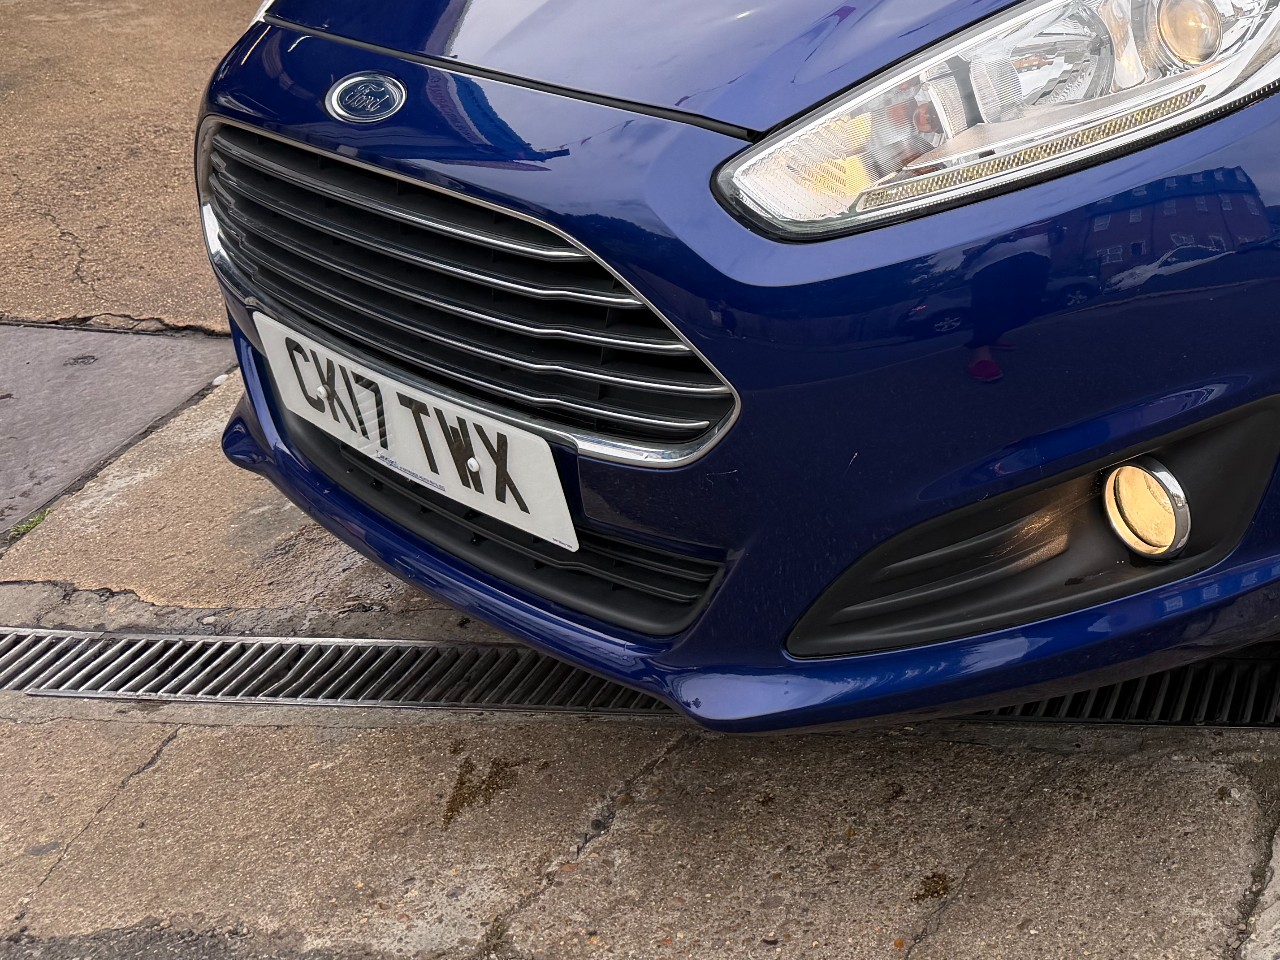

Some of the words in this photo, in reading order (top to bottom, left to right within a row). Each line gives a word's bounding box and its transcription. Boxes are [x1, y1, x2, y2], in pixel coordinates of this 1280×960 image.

[343, 82, 390, 113] Ford
[285, 336, 389, 451] CK17
[396, 391, 531, 515] TWX
